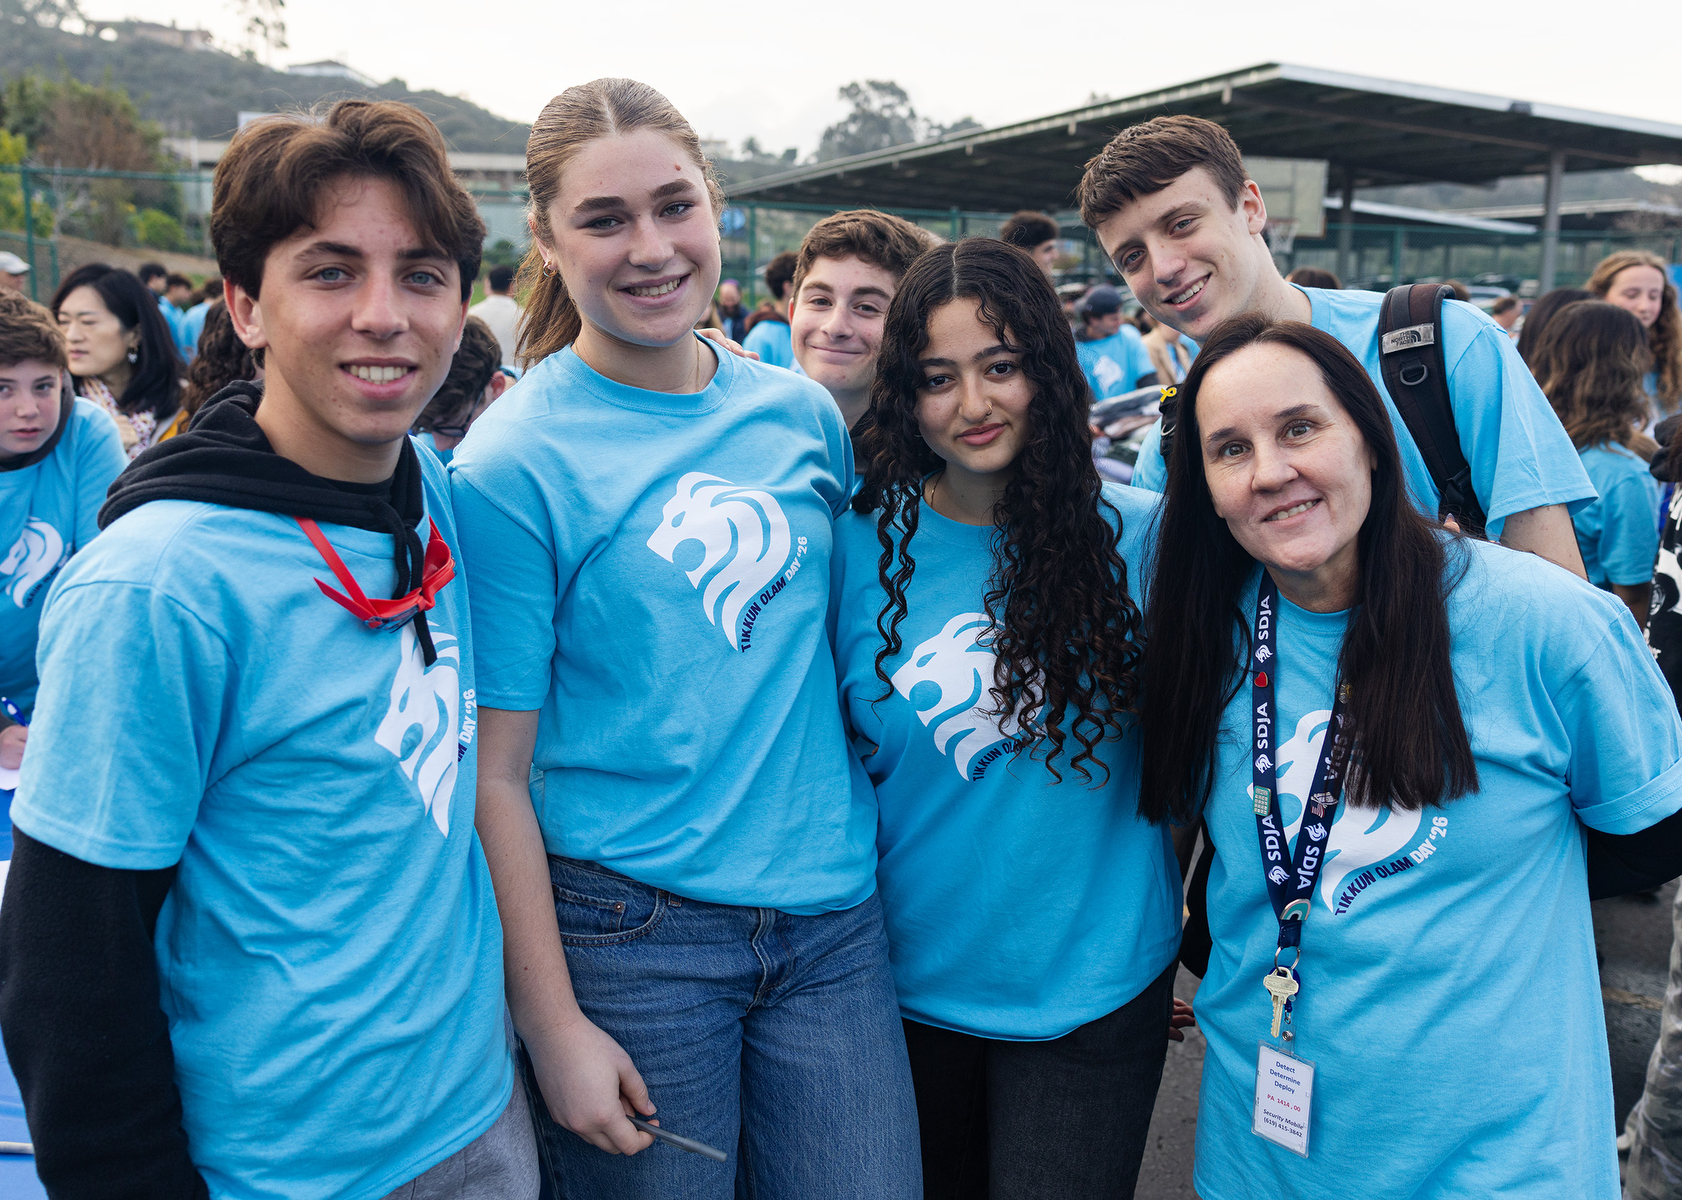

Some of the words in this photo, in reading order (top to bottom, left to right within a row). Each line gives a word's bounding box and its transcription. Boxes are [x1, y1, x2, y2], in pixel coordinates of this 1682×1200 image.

[741, 602, 762, 653] TIKKUN
[760, 576, 787, 606] OLAM
[785, 557, 801, 581] DAY
[796, 536, 808, 558] '26
[1258, 595, 1272, 640] SDJA
[463, 688, 477, 714] '26
[459, 716, 477, 744] DAY
[1256, 702, 1272, 749] SDJA
[973, 748, 1002, 781] TIKKUN
[1262, 814, 1281, 861] SDJA
[1297, 845, 1321, 890] SDJA
[1335, 870, 1376, 916] TIKKUN
[1375, 856, 1414, 879] OLAM
[1409, 838, 1437, 864] DAY
[1429, 816, 1449, 840] '26
[1270, 1069, 1301, 1086] Determine
[1276, 1061, 1296, 1074] Detect
[1274, 1080, 1295, 1095] Deploy
[1263, 1108, 1285, 1122] Security
[1284, 1118, 1304, 1130] Mobile
[1263, 1116, 1278, 1128] (619)
